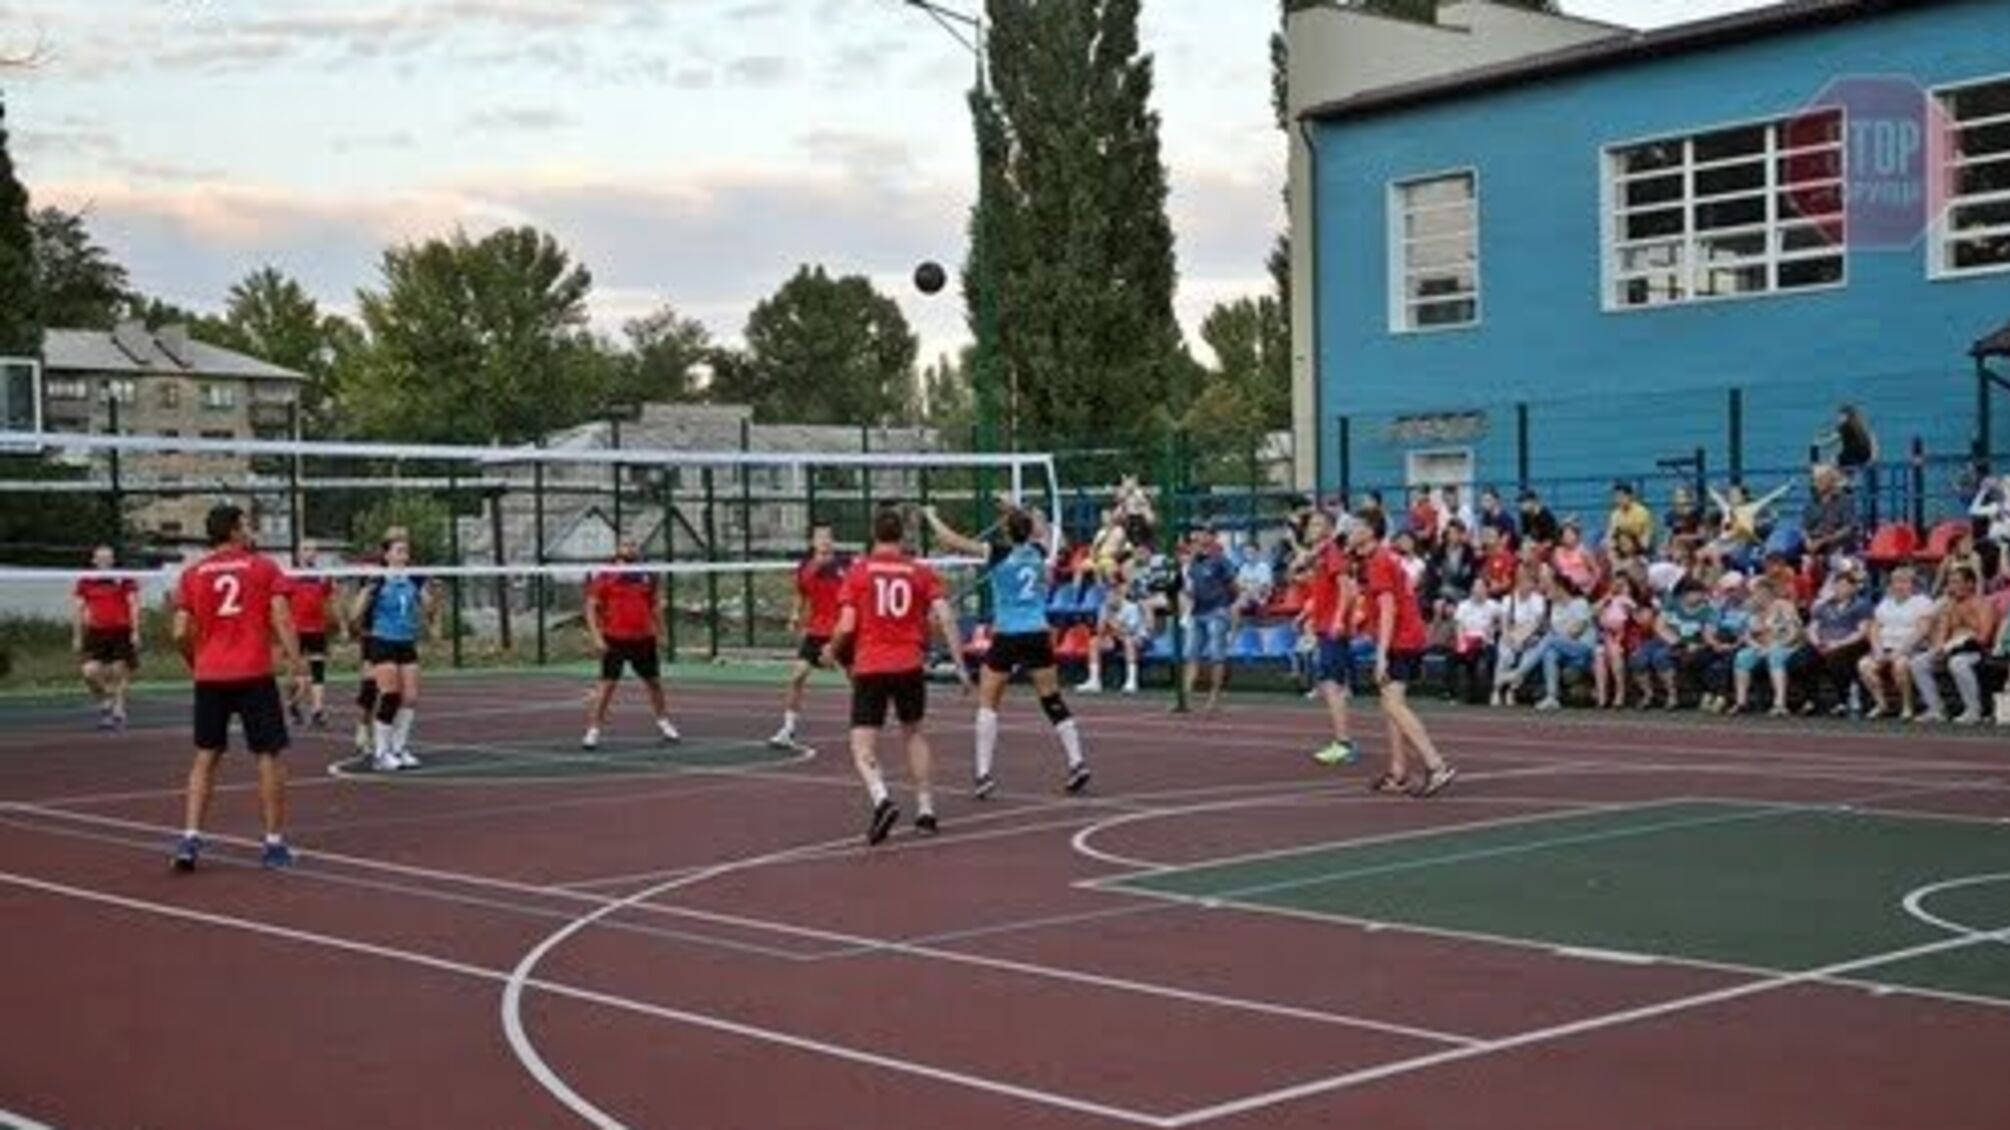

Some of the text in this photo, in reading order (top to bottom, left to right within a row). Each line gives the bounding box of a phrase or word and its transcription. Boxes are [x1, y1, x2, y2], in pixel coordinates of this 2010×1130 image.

[213, 574, 242, 617] 2
[873, 577, 912, 617] 10
[1016, 566, 1037, 600] 2
